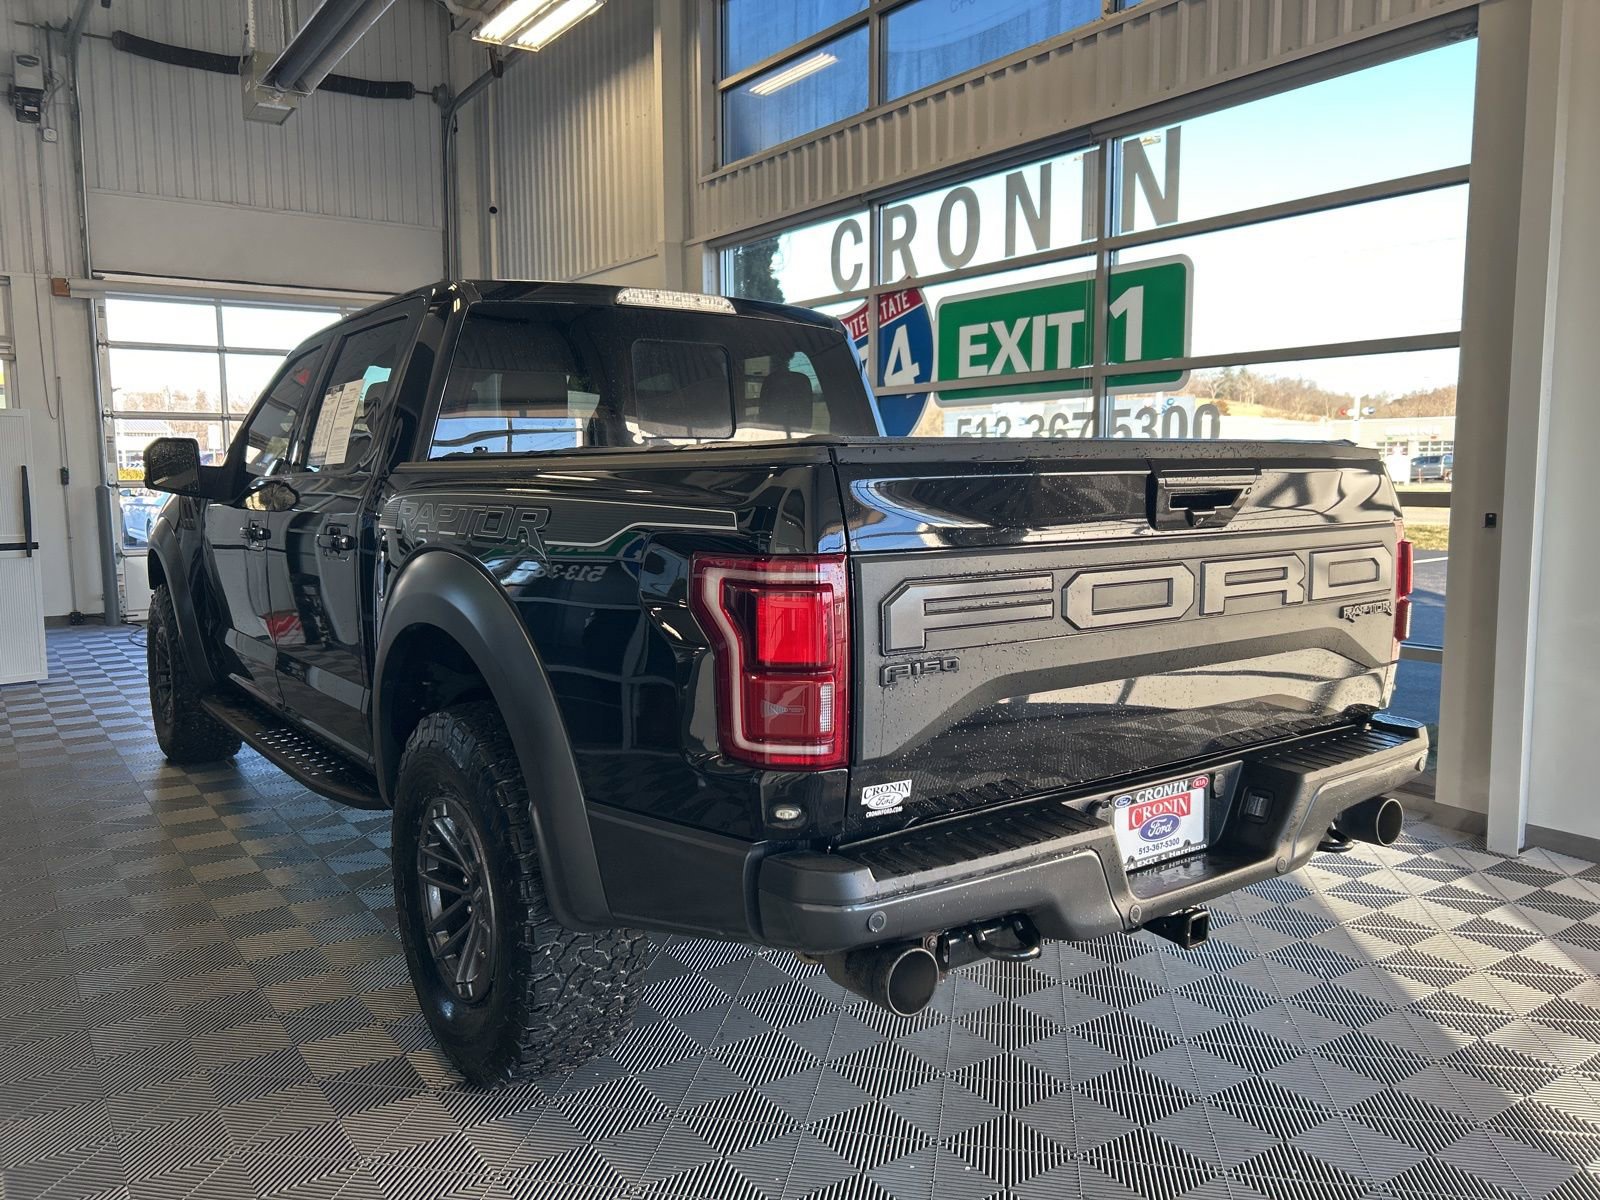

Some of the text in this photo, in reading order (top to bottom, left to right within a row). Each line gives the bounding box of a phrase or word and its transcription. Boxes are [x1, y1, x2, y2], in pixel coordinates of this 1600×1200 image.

[831, 126, 1181, 292] CRONIN
[958, 286, 1145, 378] EXIT 1
[398, 501, 551, 560] RAPTOR
[882, 543, 1392, 656] FORD
[1340, 600, 1393, 622] RAPTOR
[864, 781, 910, 800] CRONIN
[875, 795, 896, 806] Ford
[1136, 780, 1188, 803] CRONIN
[1131, 796, 1188, 828] CRONIN
[1147, 818, 1173, 837] Ford
[1137, 856, 1159, 867] EXIT
[1169, 843, 1207, 858] Harrison
[1138, 837, 1180, 855] 513-367-5300
